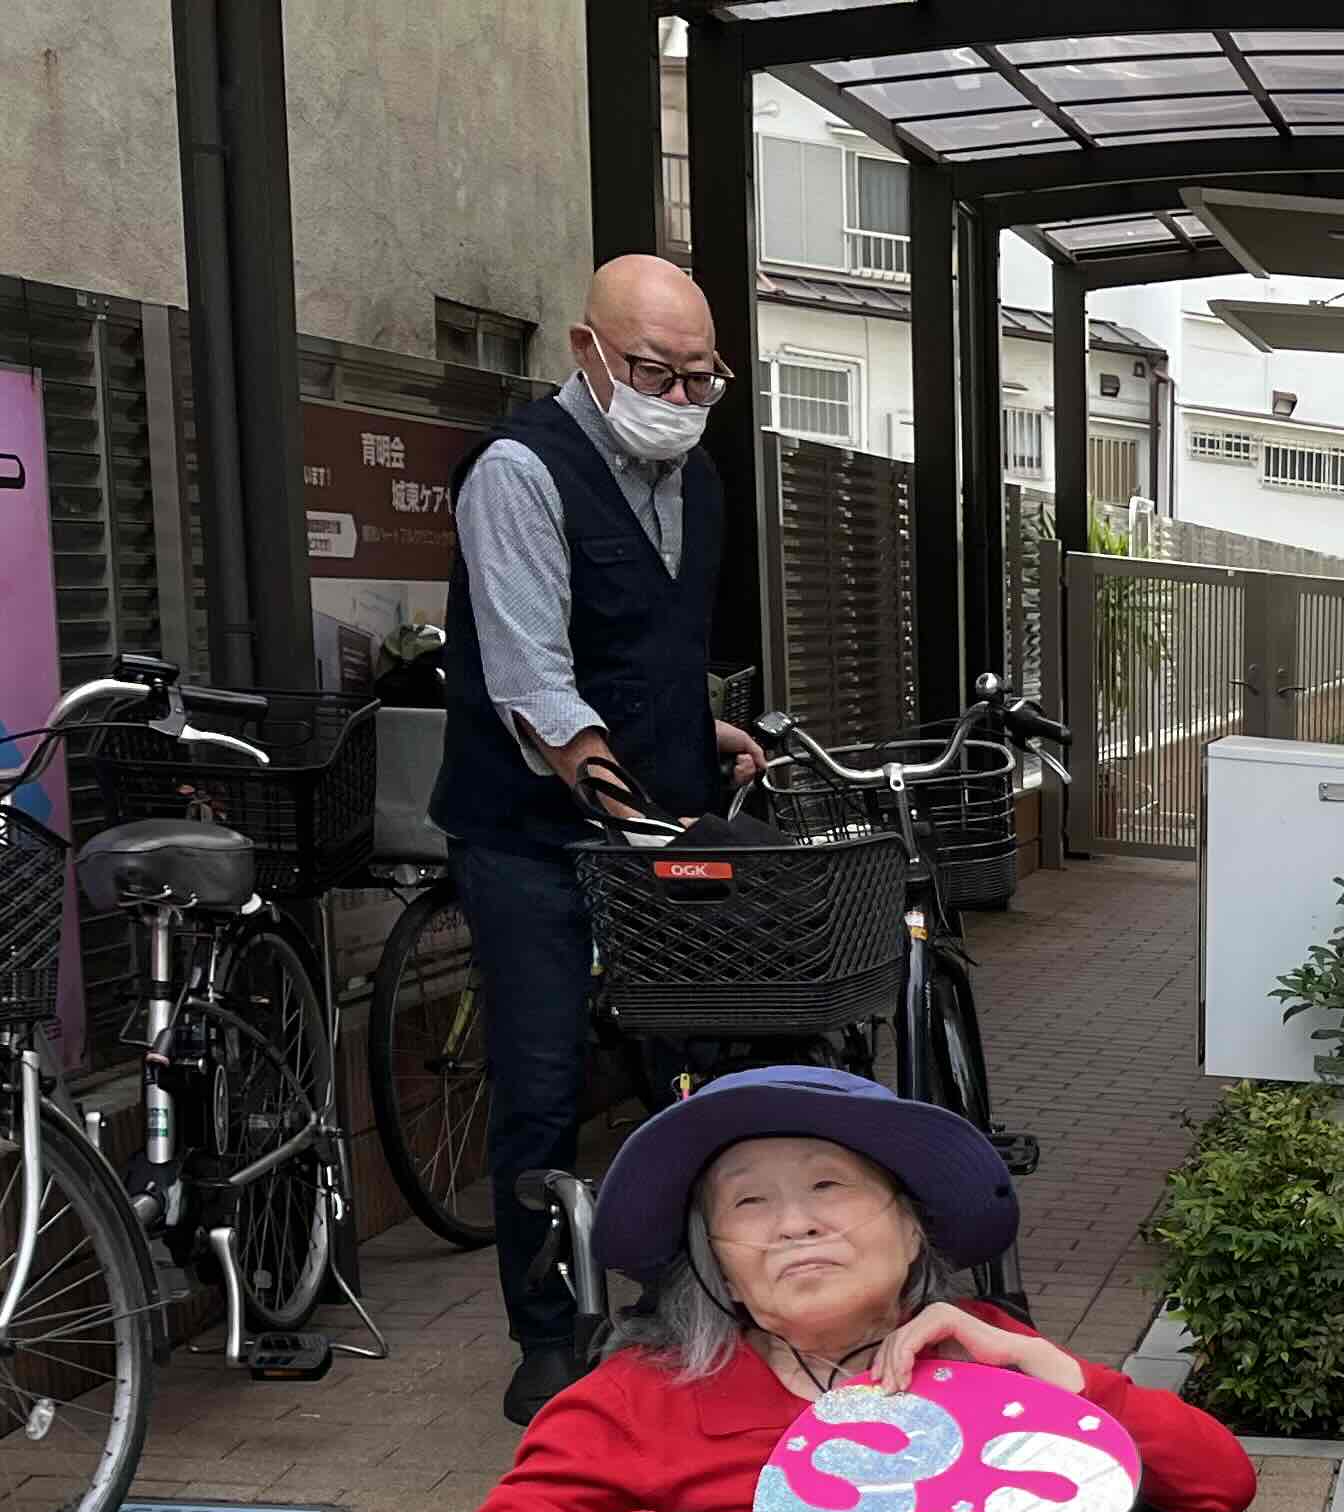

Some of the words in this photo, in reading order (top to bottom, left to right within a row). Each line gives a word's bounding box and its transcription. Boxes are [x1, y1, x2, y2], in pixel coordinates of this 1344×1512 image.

[361, 432, 405, 469] 育明会
[670, 864, 706, 877] OGK
